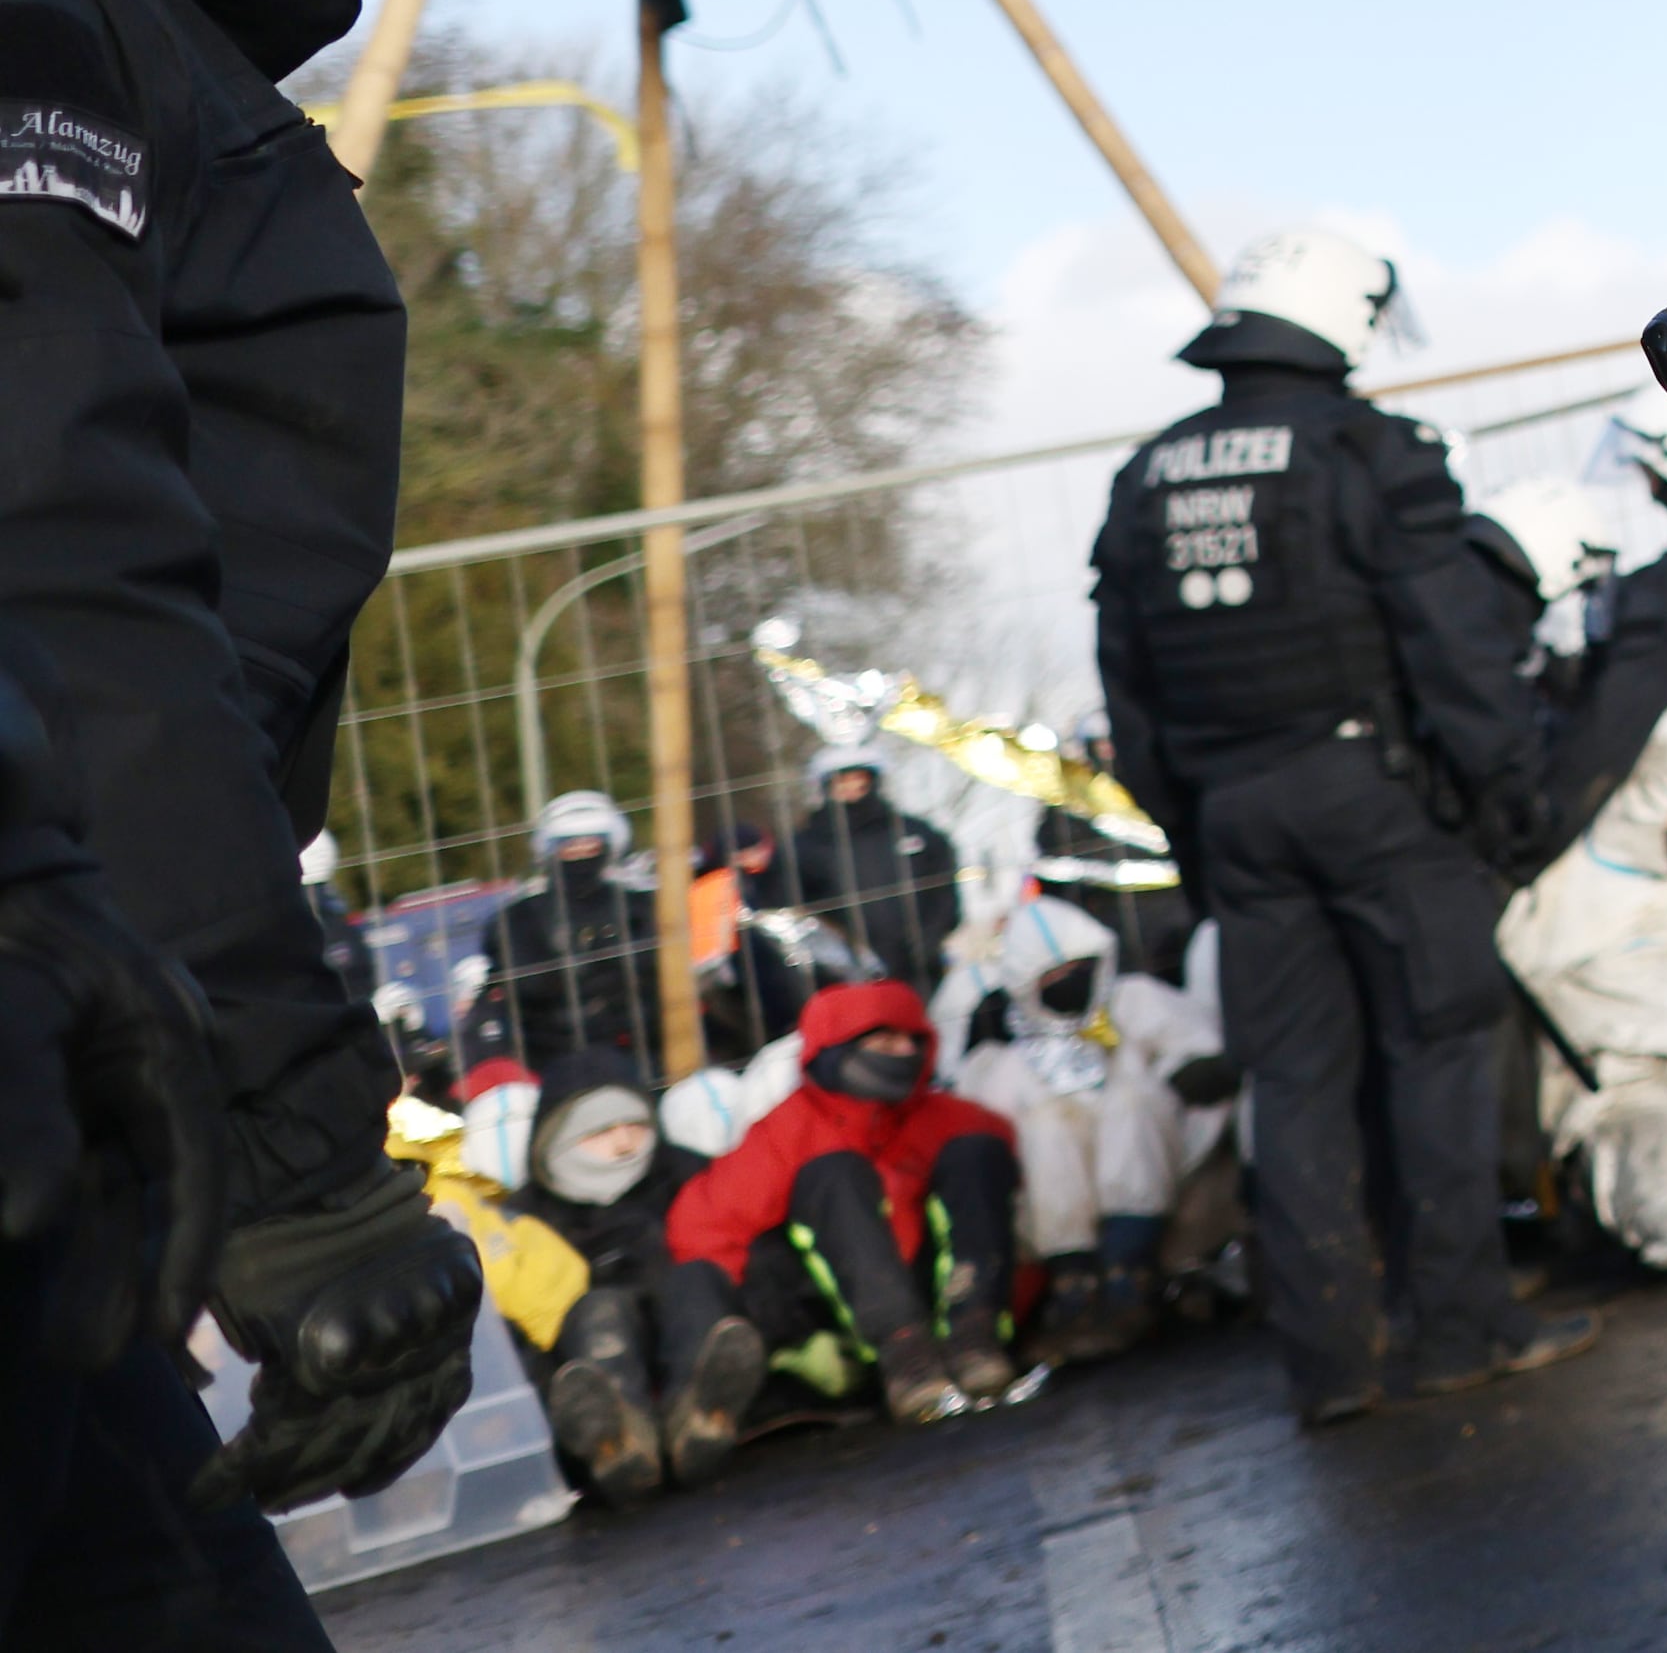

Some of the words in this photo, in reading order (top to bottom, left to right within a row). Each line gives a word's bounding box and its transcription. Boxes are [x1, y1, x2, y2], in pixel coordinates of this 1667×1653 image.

[10, 110, 142, 176] Alarmzug
[1145, 425, 1293, 488] POLIZEI
[1166, 485, 1254, 528] NRW
